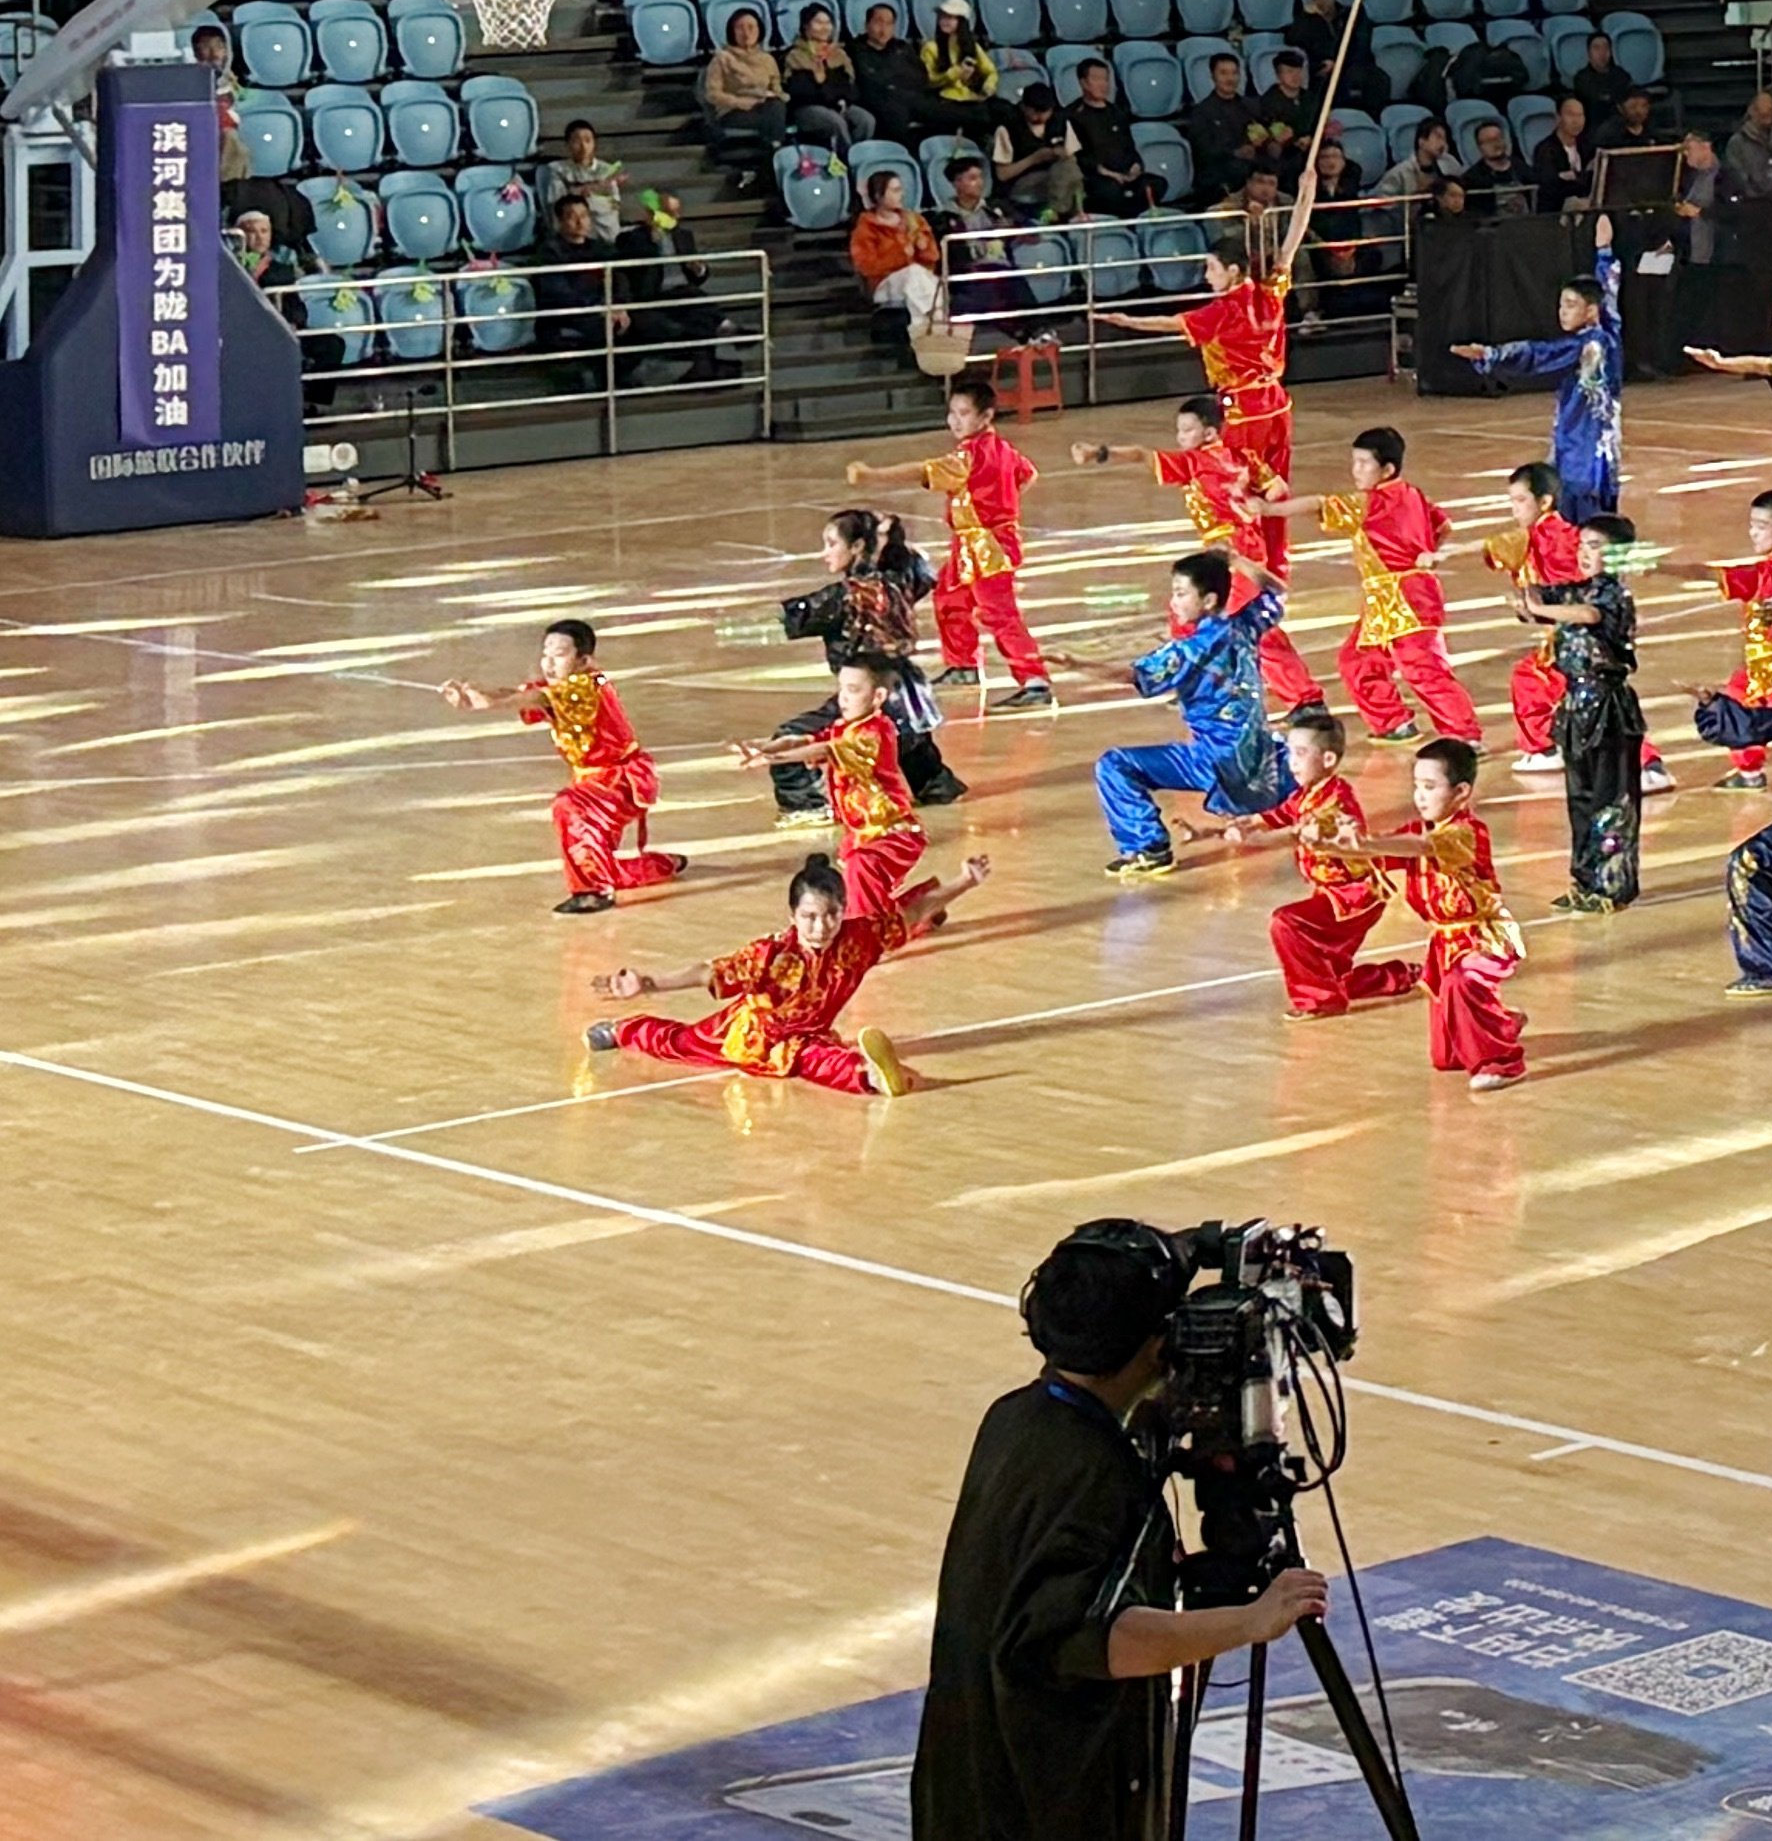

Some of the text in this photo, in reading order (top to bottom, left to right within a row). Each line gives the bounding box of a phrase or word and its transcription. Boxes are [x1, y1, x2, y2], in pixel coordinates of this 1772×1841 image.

[151, 121, 189, 427] 滨河集团为陇BA加油
